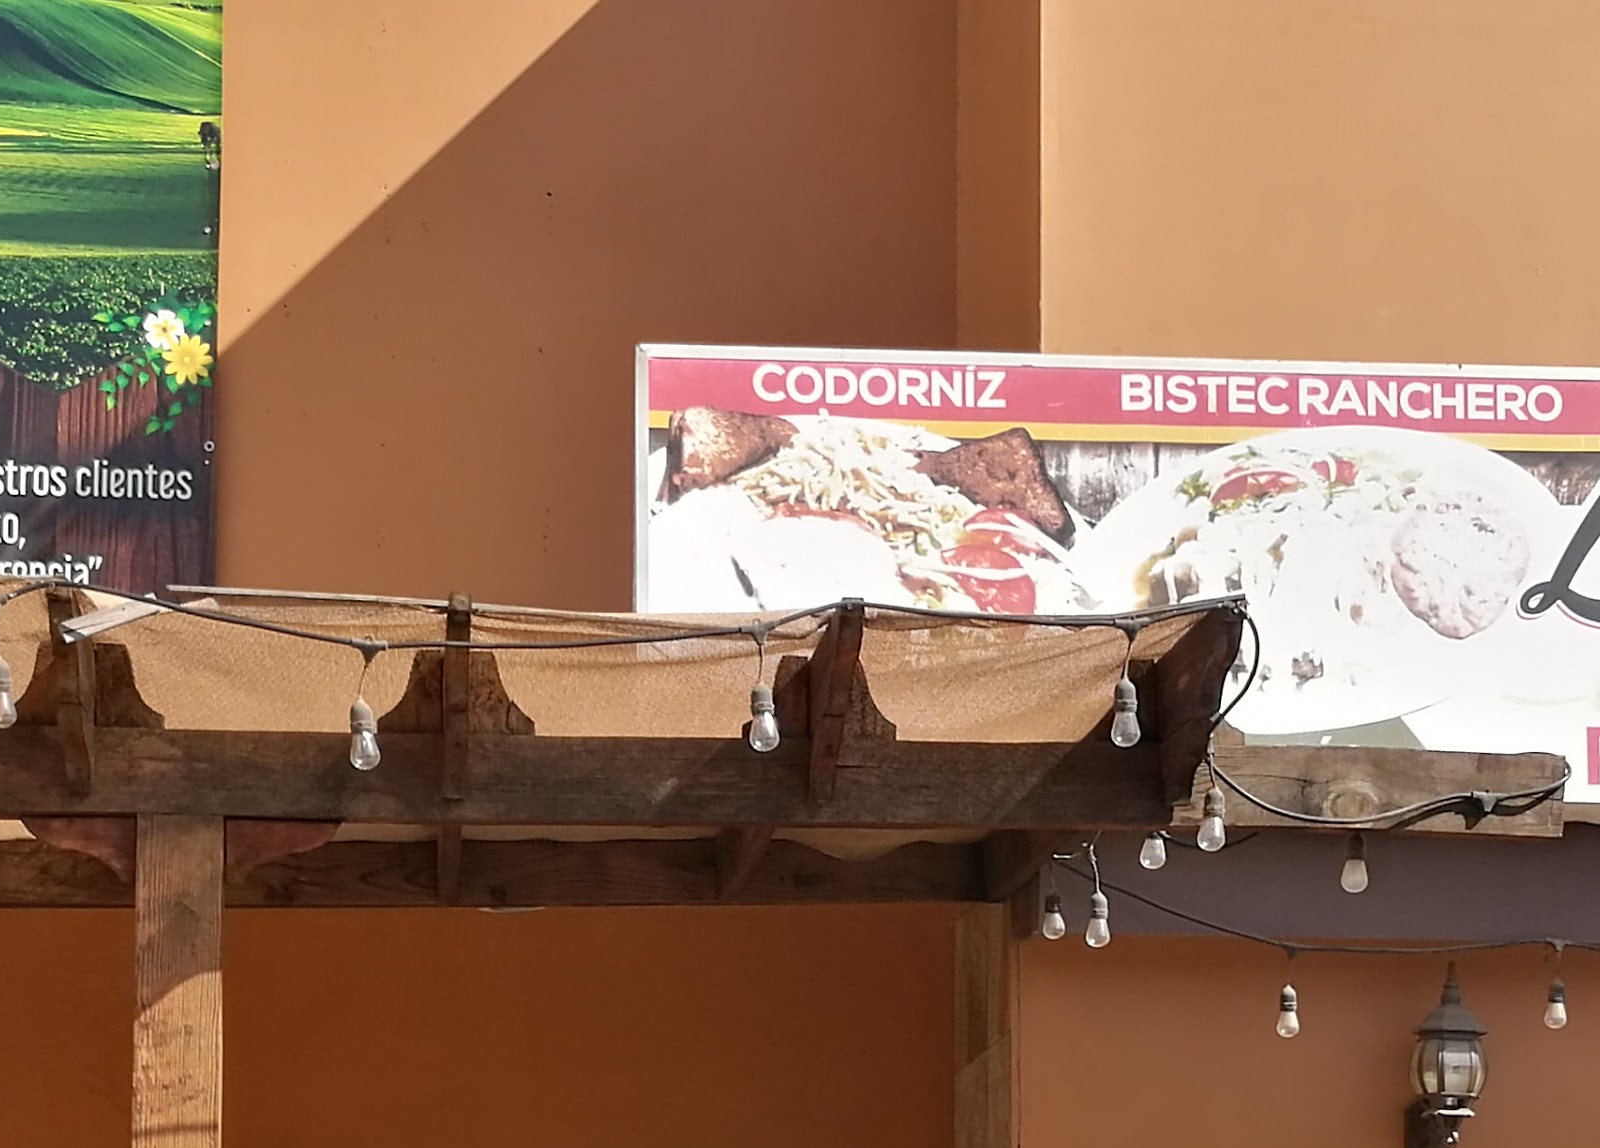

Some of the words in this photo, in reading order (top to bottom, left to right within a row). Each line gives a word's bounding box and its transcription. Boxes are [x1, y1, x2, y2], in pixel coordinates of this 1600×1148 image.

[752, 363, 1007, 409] CODORNÍZ
[1120, 372, 1290, 415] BISTEC
[1298, 377, 1564, 423] RANCHERO
[75, 459, 193, 500] clientes
